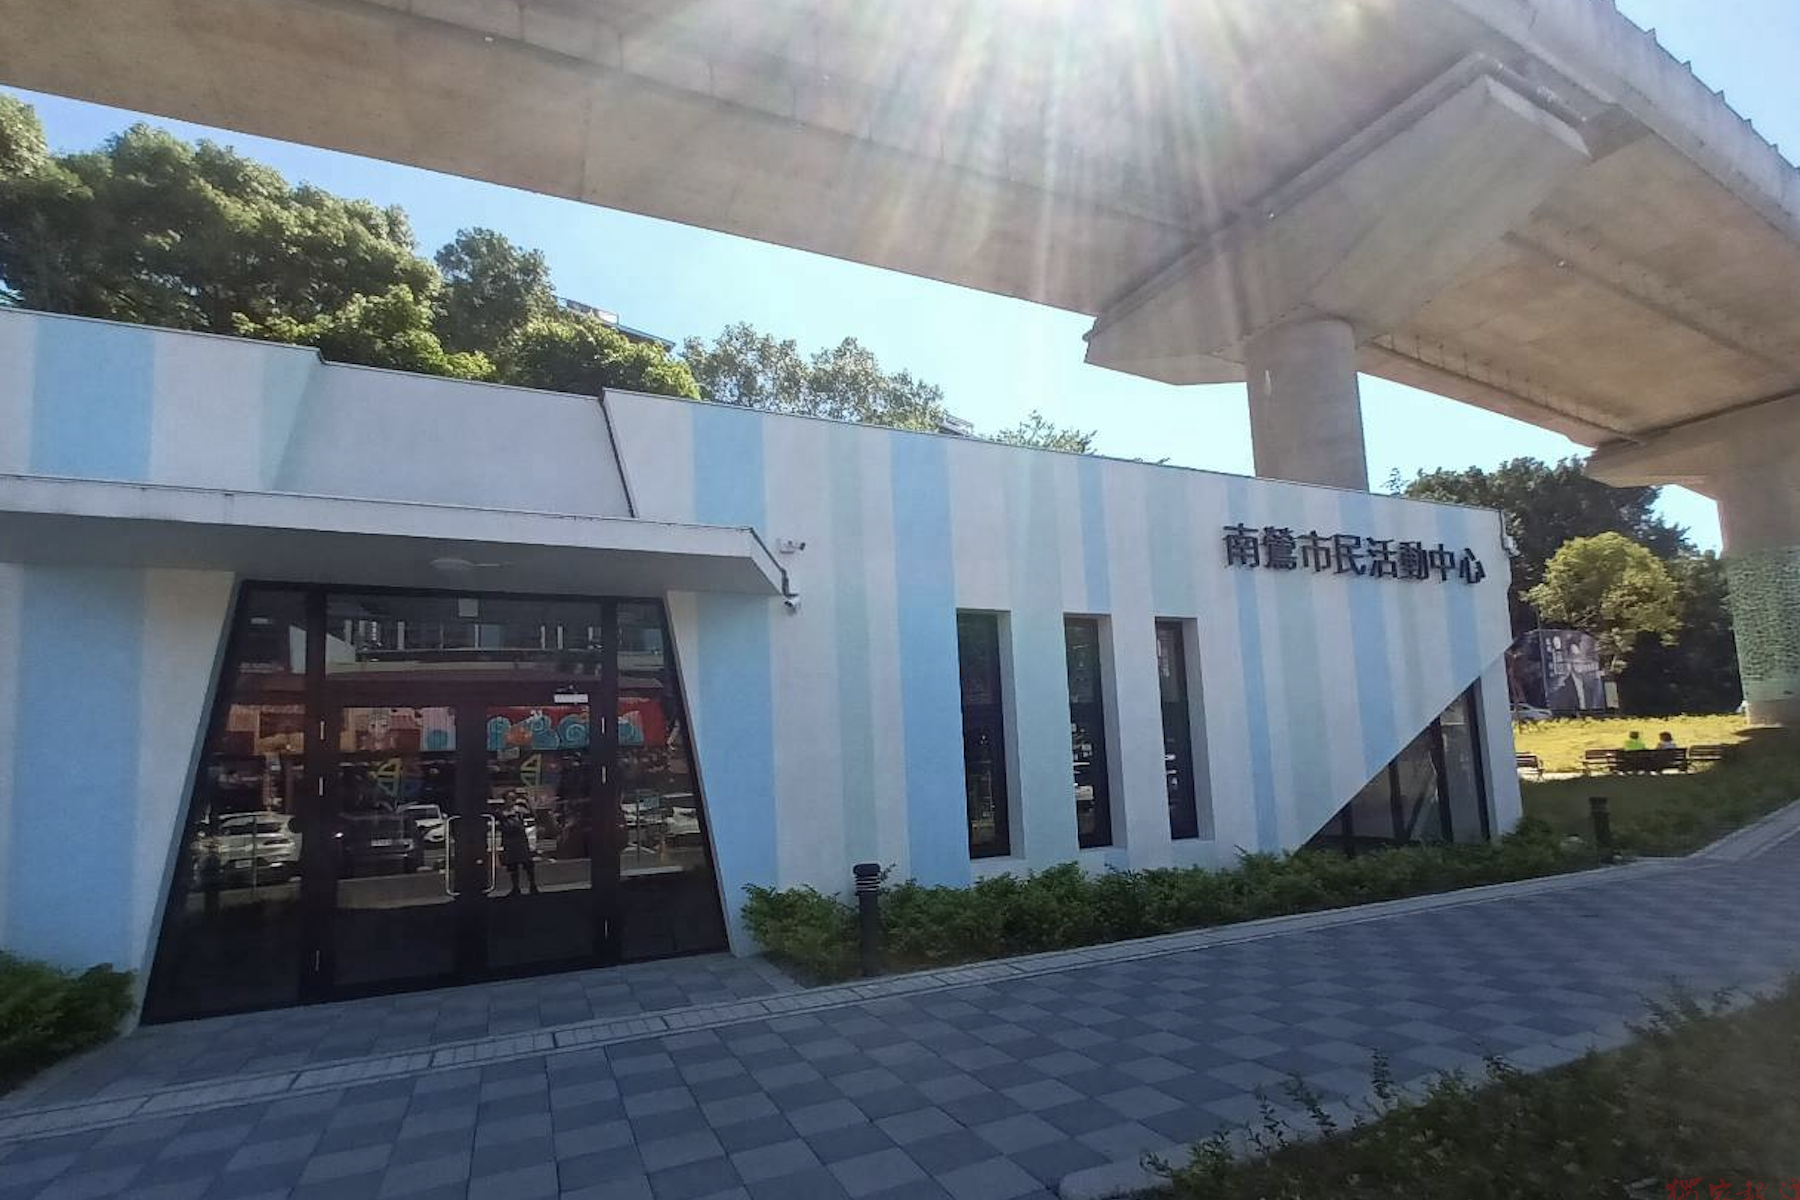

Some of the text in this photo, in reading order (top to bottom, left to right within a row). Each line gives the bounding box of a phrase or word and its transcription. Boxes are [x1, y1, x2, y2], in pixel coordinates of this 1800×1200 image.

[1222, 522, 1486, 584] 南鶯市民活動中心
